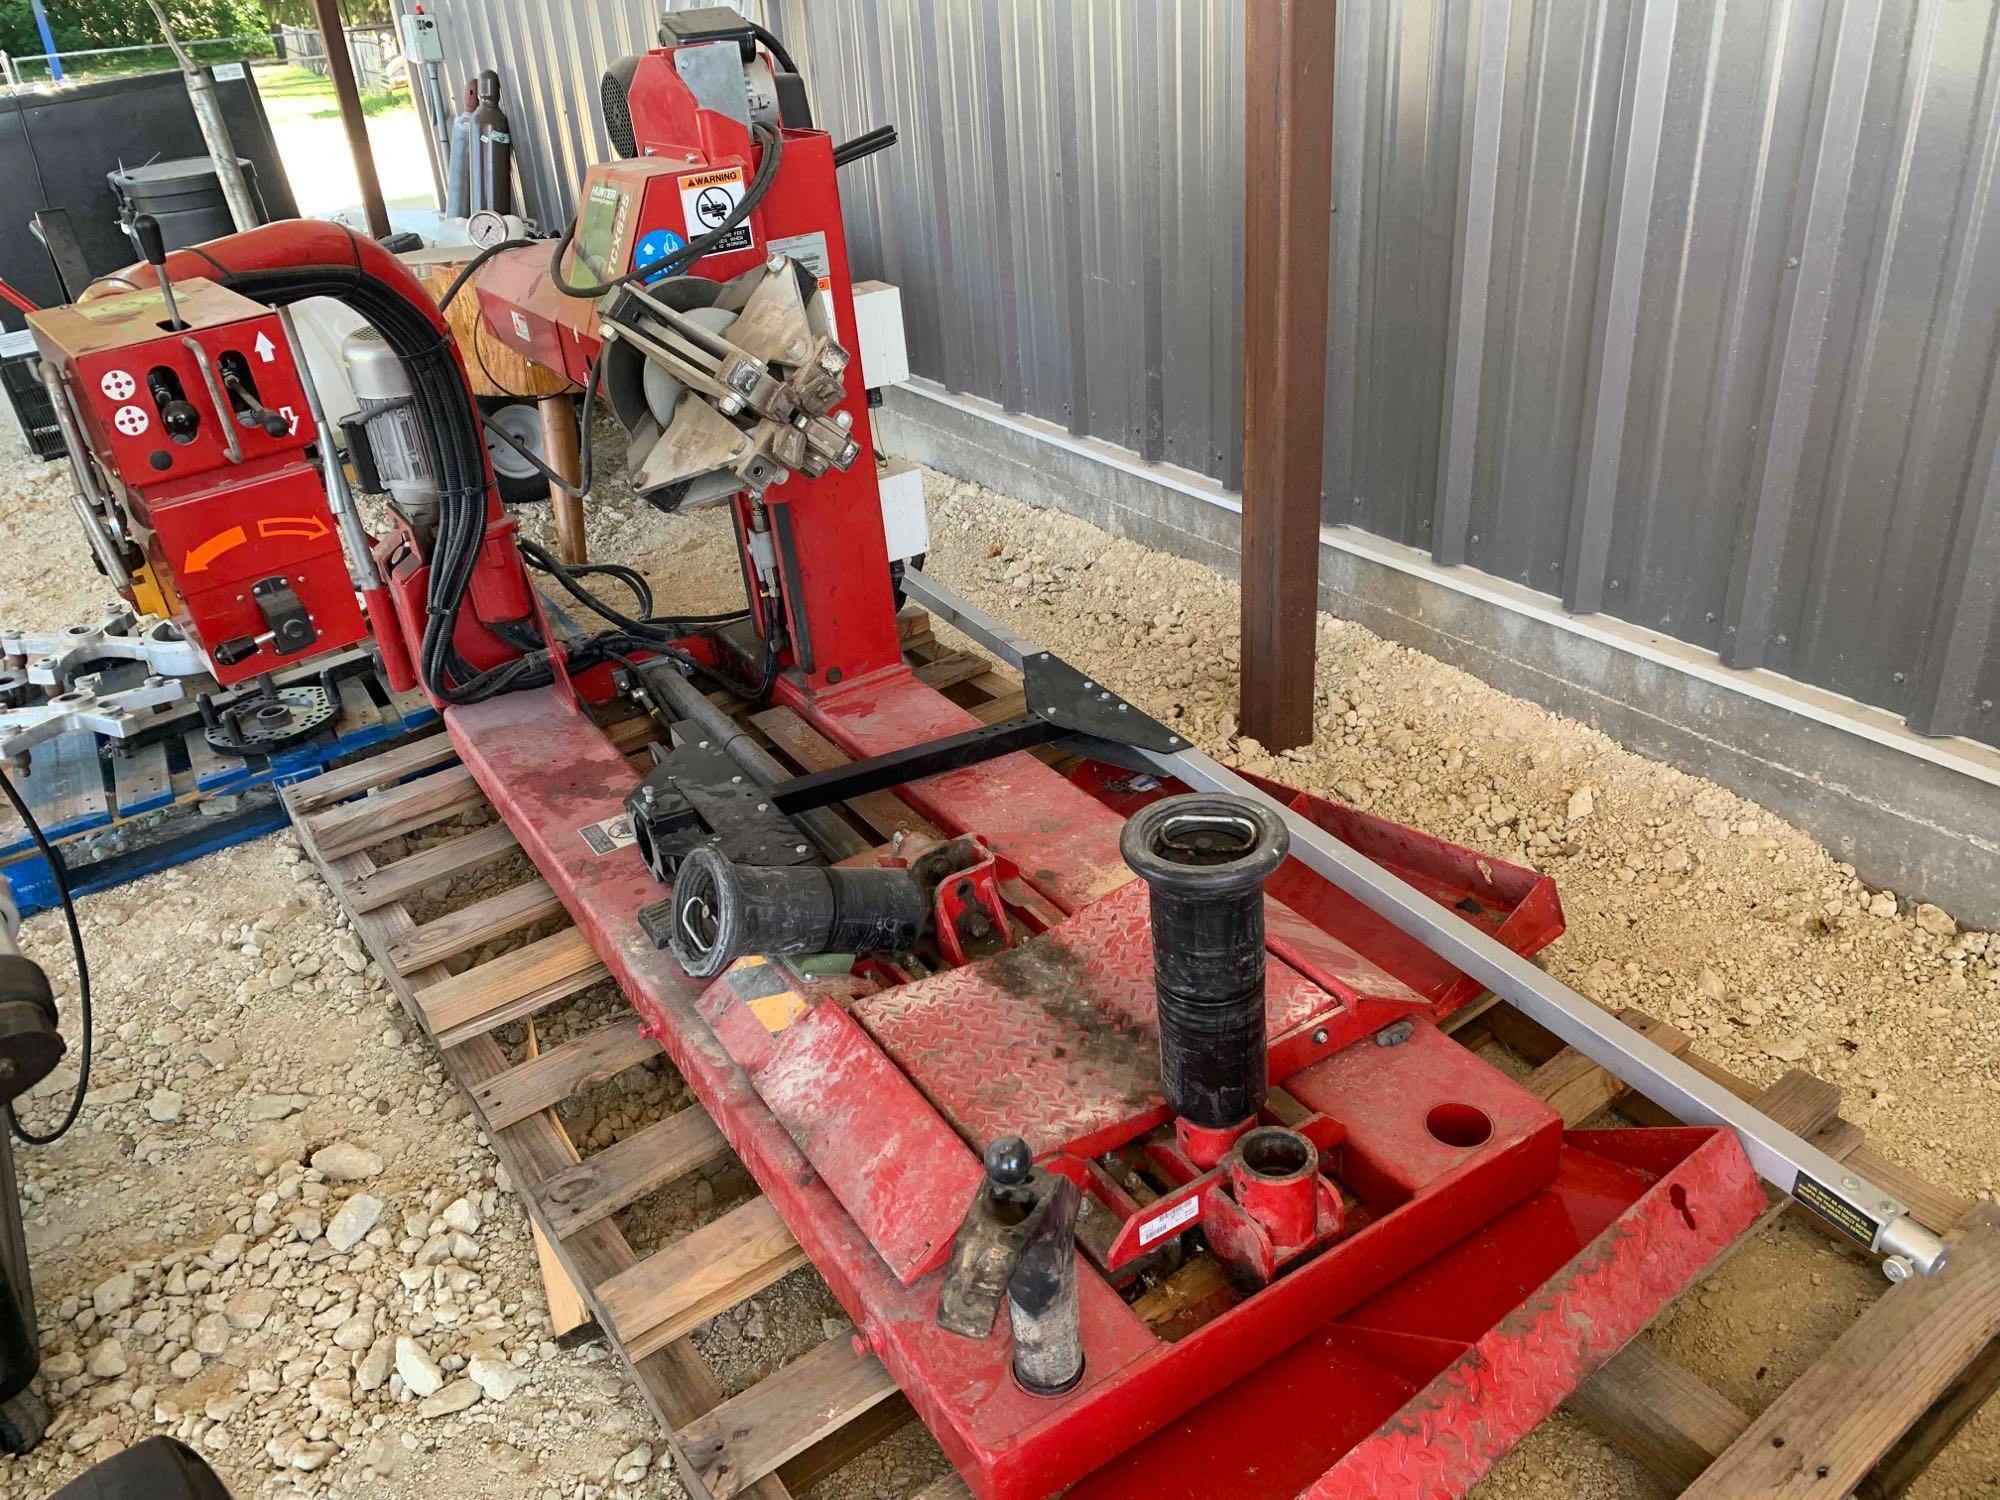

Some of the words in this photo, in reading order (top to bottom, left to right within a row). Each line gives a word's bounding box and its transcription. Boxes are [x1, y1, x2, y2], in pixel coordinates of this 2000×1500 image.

[695, 171, 737, 185] WARNING
[590, 185, 617, 199] HUNTER
[607, 192, 630, 276] TCX625
